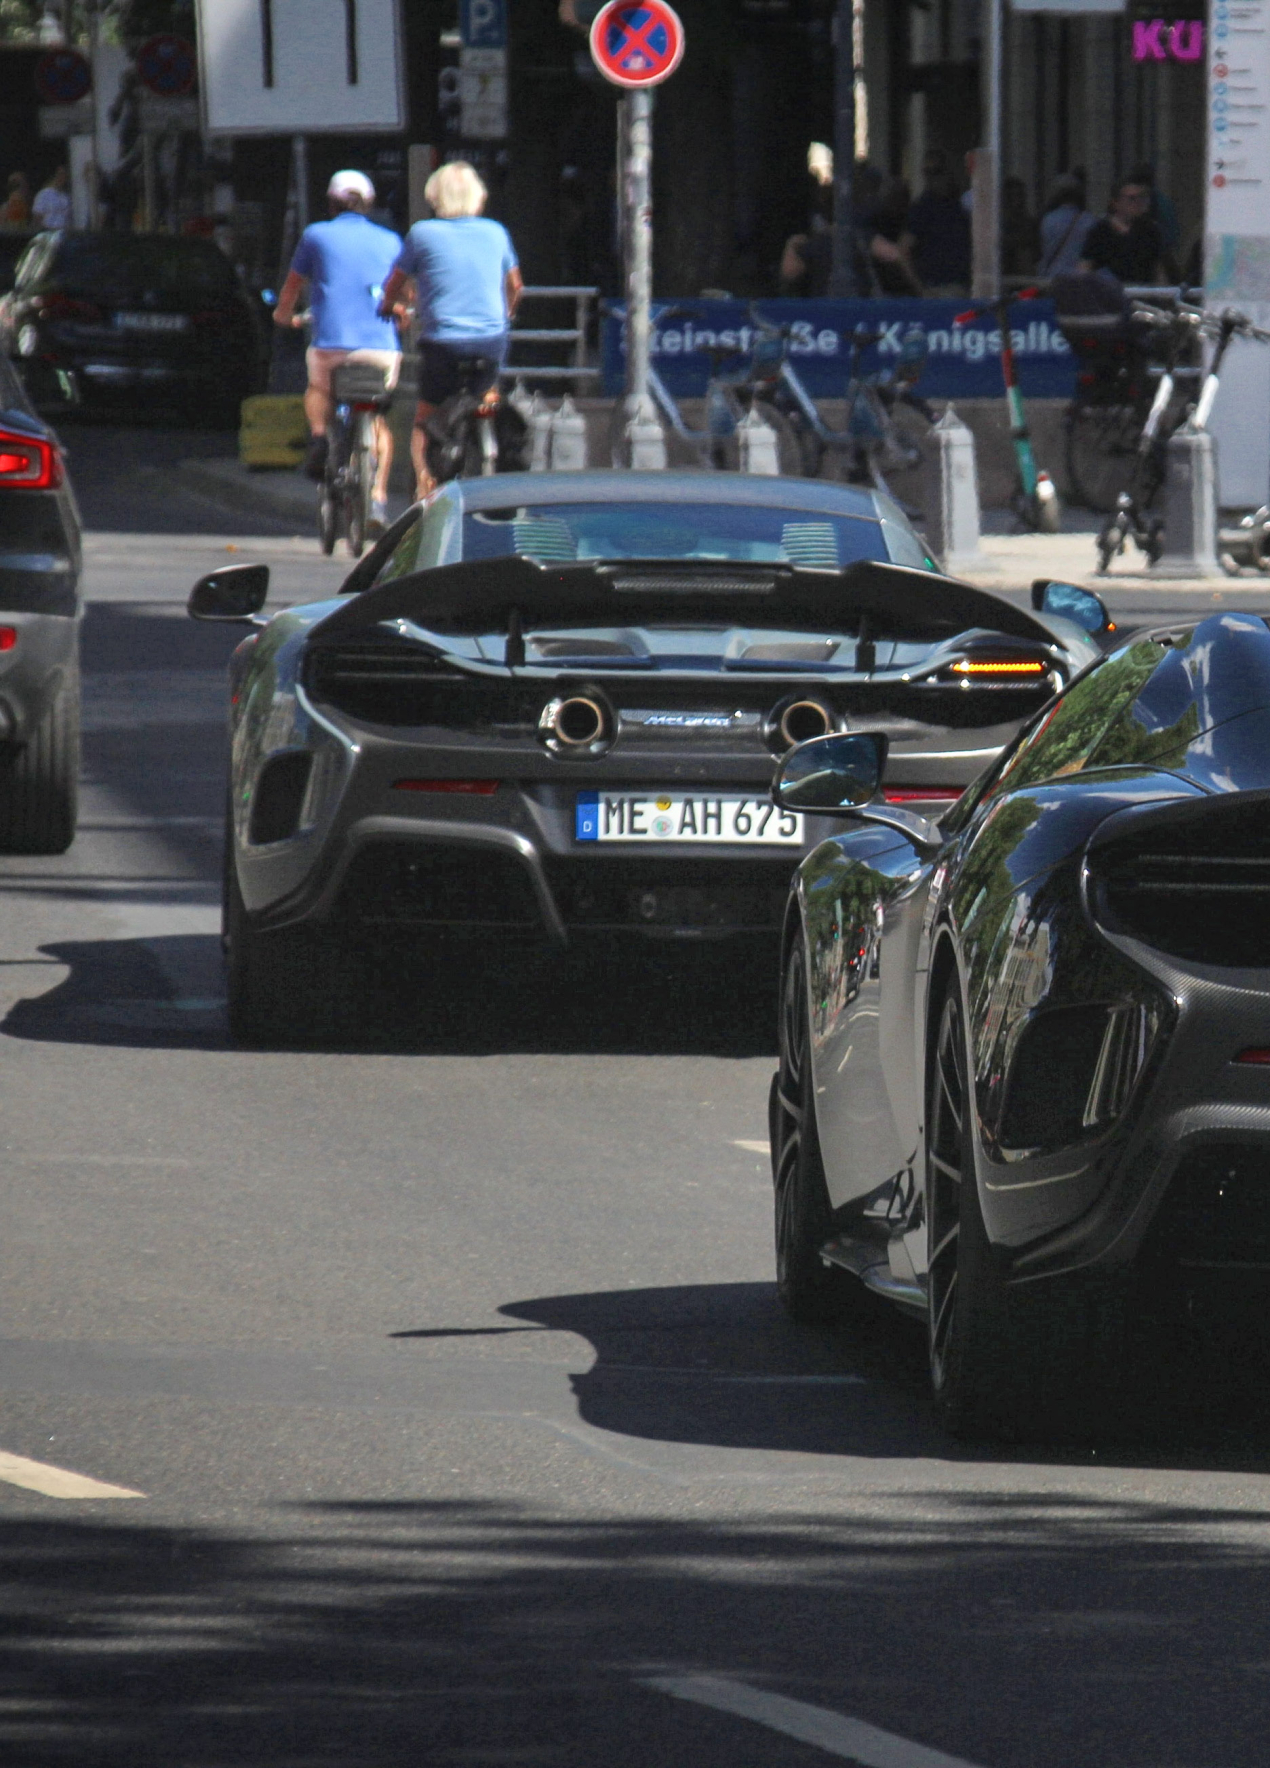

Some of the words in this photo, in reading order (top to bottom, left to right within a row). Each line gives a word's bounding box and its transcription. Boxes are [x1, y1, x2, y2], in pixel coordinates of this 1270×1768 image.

[583, 821, 592, 833] D
[603, 797, 648, 835] ME
[678, 798, 723, 836] AH
[733, 798, 798, 837] 675
